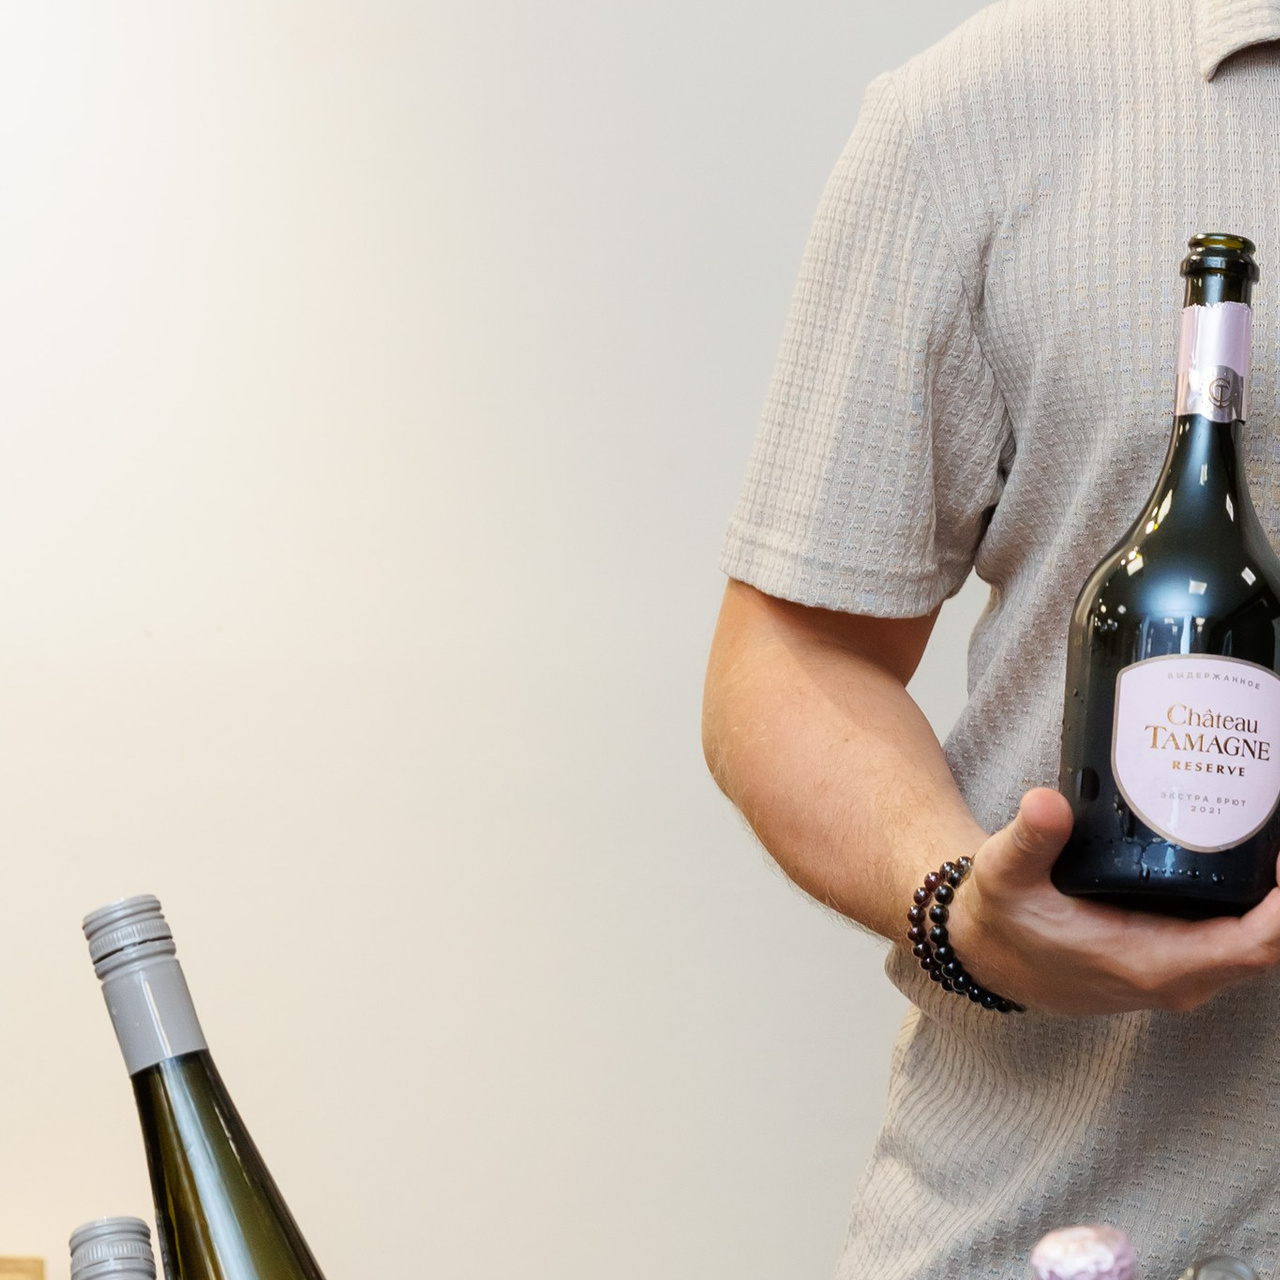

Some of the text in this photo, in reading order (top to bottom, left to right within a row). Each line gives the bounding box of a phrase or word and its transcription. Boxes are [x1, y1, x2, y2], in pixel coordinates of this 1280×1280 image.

[1167, 671, 1261, 691] ВЫДЕРЖАННОЕ
[1166, 703, 1258, 734] Château
[1144, 725, 1271, 762] TAMAGNE
[1172, 761, 1246, 777] RESERVE
[1161, 792, 1247, 808] ЭКСТРА БРЮТ
[1190, 805, 1222, 815] 2021
